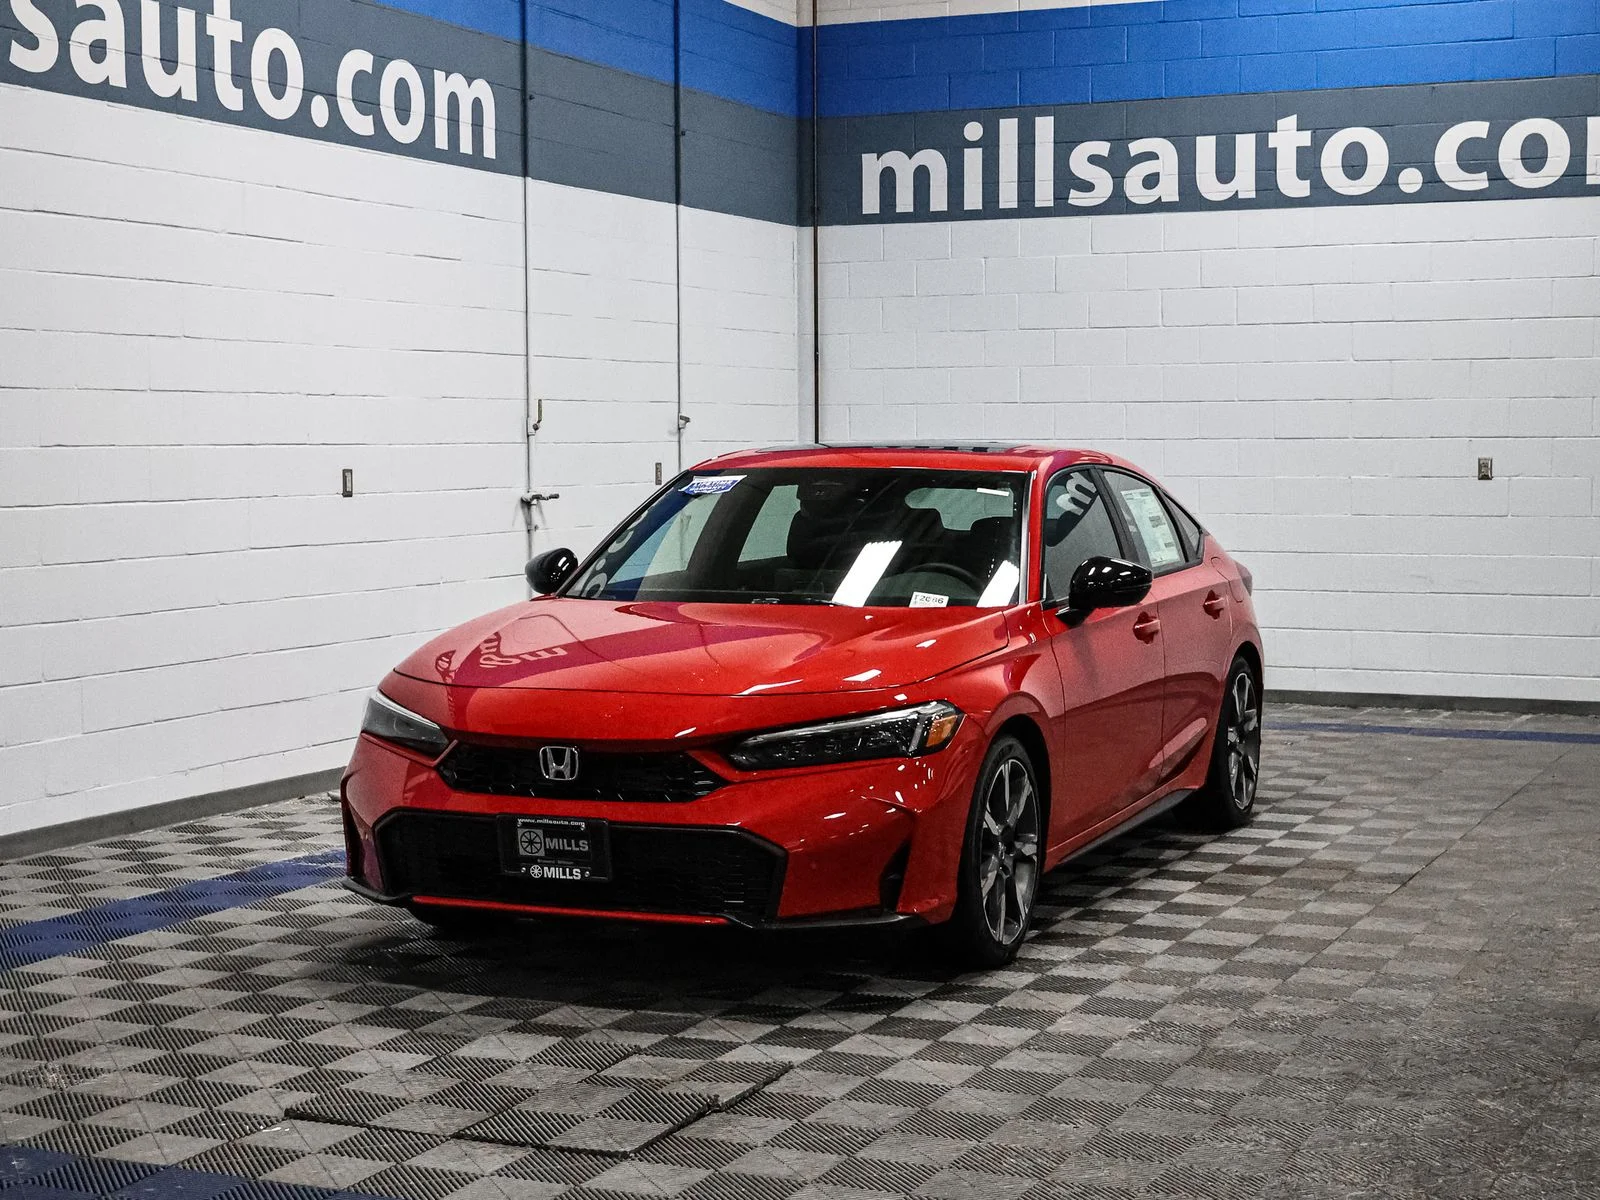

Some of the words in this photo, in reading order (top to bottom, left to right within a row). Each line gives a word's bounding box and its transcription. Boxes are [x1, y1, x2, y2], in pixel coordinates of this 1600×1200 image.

[9, 0, 497, 160] sauto.com
[545, 837, 589, 851] MILLS
[543, 866, 582, 880] MILLS
